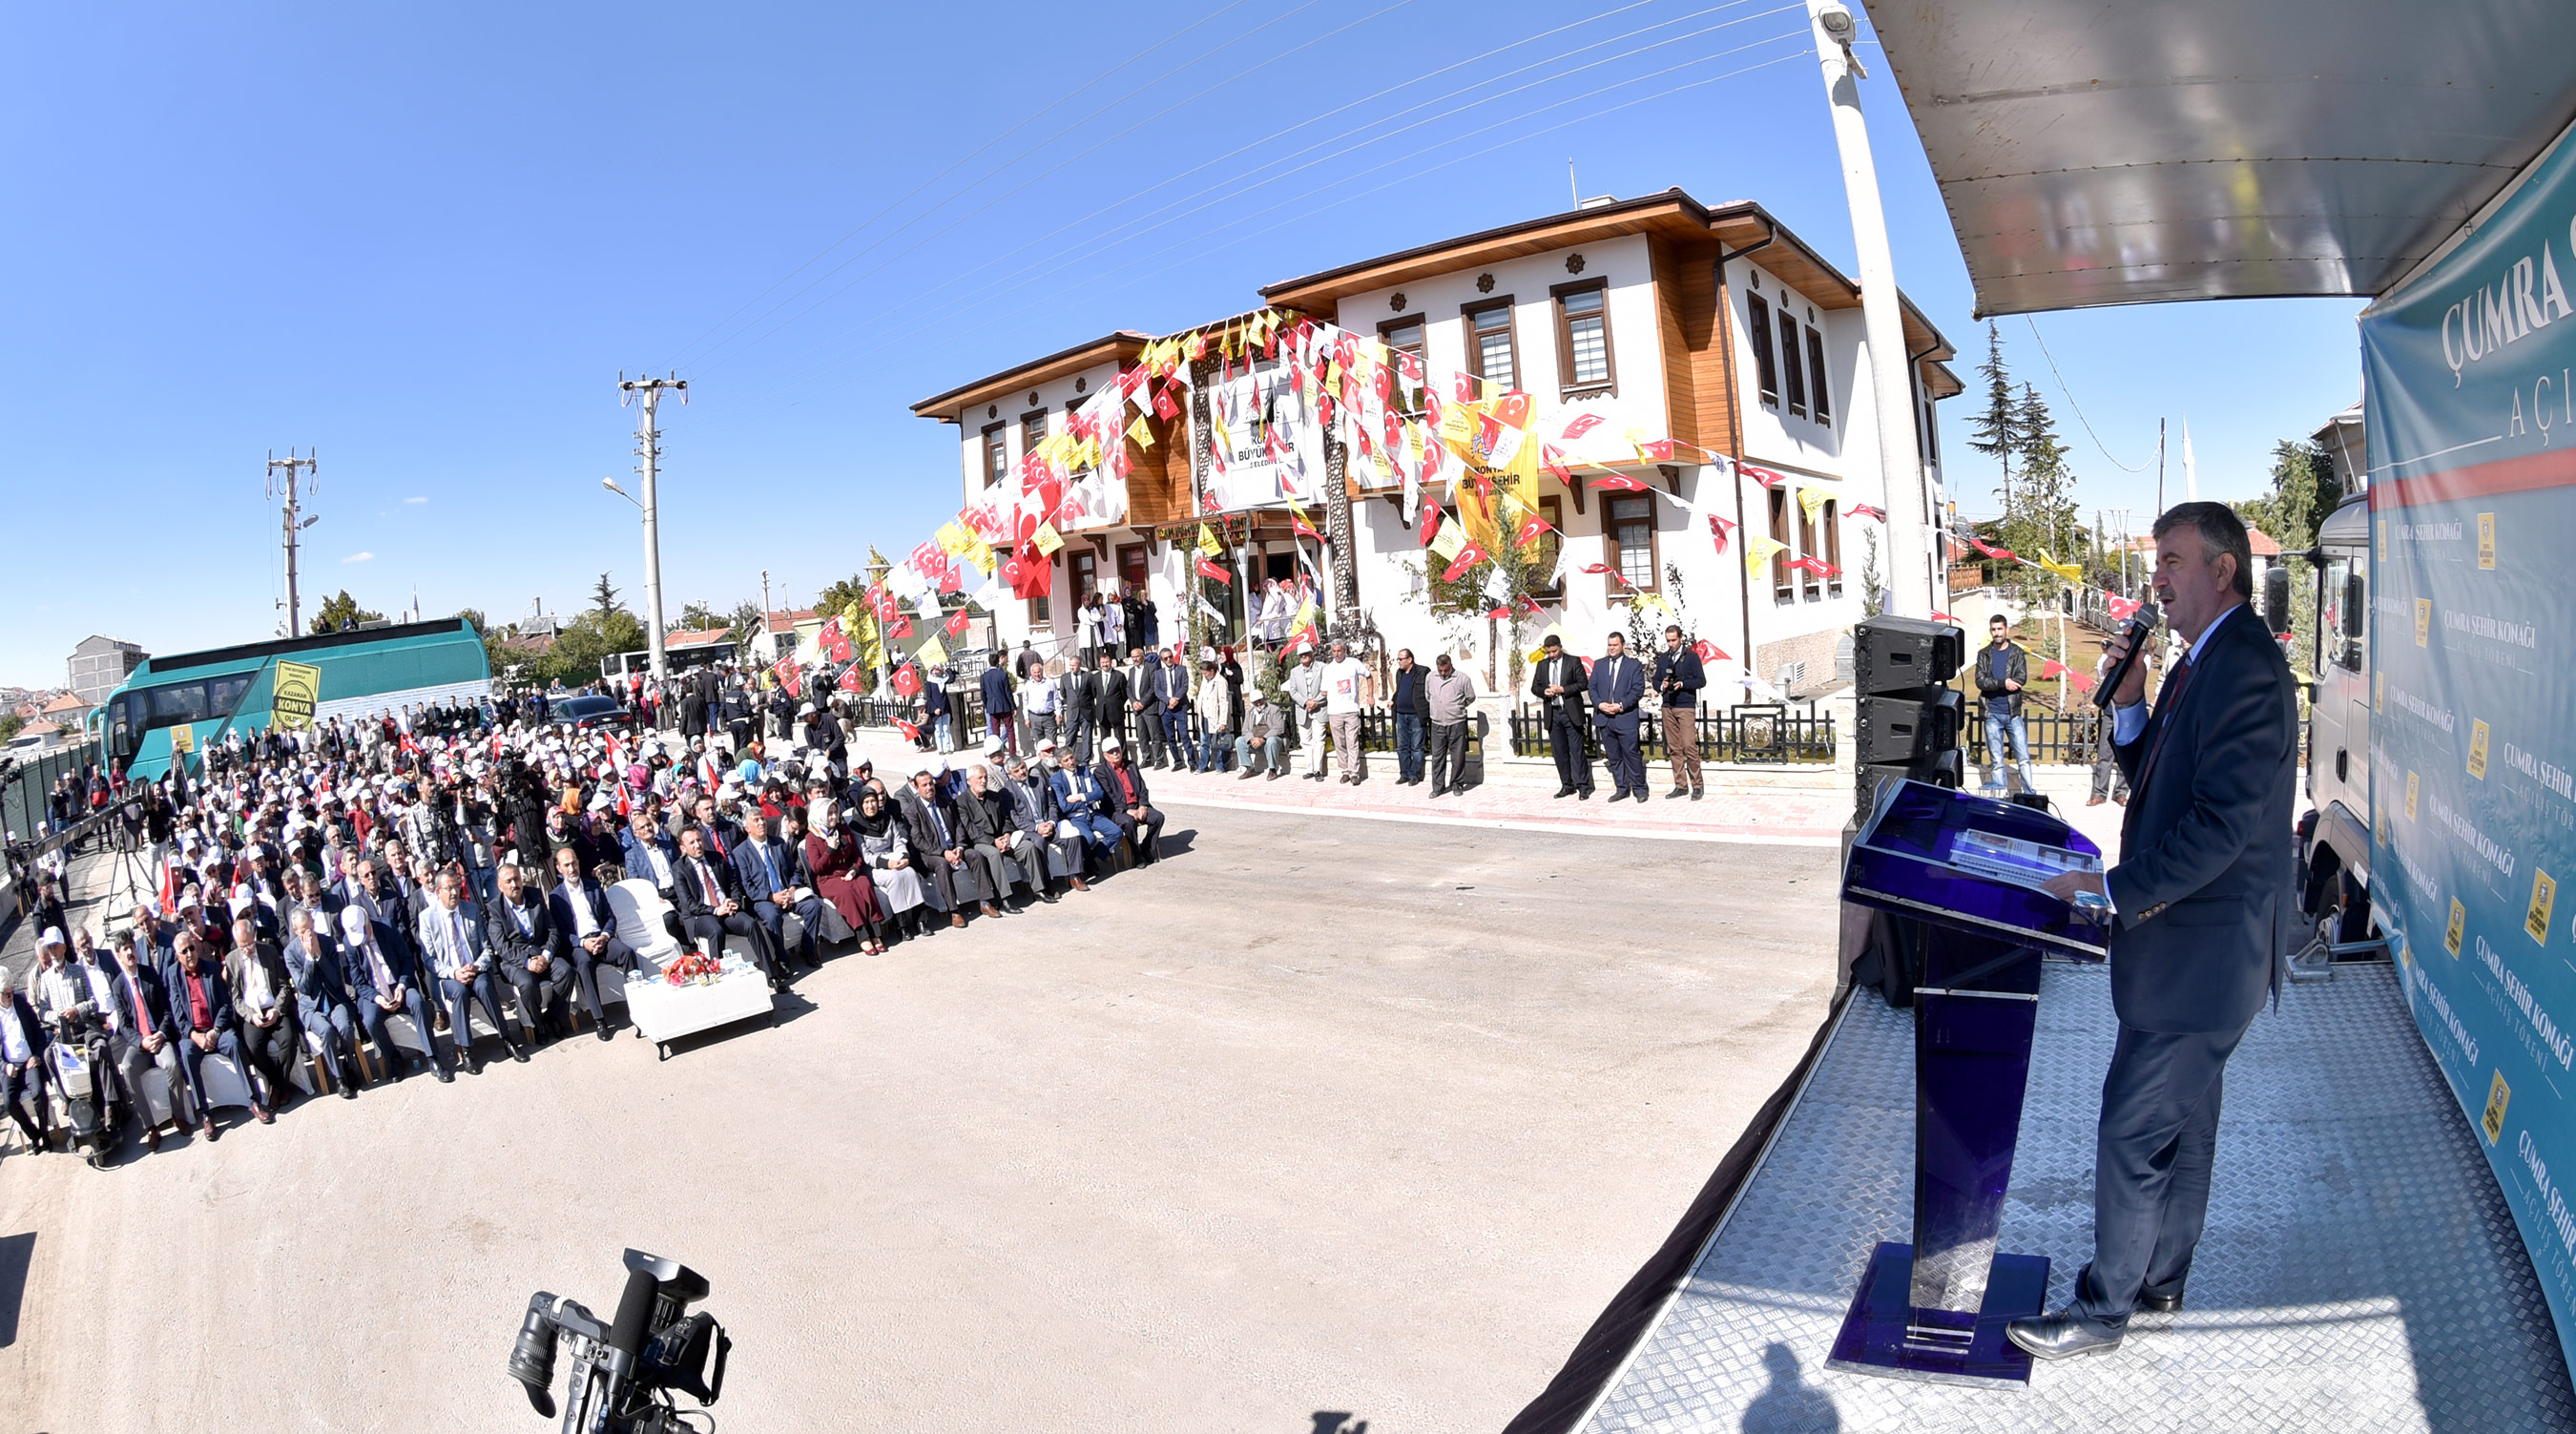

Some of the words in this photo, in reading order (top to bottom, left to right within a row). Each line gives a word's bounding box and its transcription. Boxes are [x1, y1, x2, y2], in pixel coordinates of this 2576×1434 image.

[2441, 238, 2574, 389] ÇUMRA
[2444, 610, 2470, 633] ÇUMRA
[2471, 613, 2497, 639] ŞEHİR
[2498, 620, 2535, 649] KONAĞI
[278, 698, 311, 715] KONYA
[2408, 694, 2425, 718] ŞEHİR
[2426, 704, 2455, 734] KONAĞI
[2503, 742, 2538, 780] ÇUMRA
[2539, 760, 2573, 800] ŞEHİR
[2429, 794, 2453, 829] ÇUMRA
[2453, 813, 2477, 849] ŞEHİR
[2476, 831, 2515, 879] KONAĞI
[2427, 982, 2450, 1025] ŞEHİR
[2448, 1010, 2480, 1068] KONAĞI
[2476, 934, 2504, 987] ÇUMRA
[2503, 968, 2533, 1021] ŞEHİR
[2531, 1001, 2574, 1072] KONAĞI
[2484, 981, 2512, 1027] AÇILIŞ
[2513, 1017, 2549, 1073] TÖRENİ
[2519, 1130, 2551, 1201] ÇUMRA
[2546, 1186, 2576, 1258] ŞEHİR
[2523, 1189, 2552, 1252] AÇILIŞ
[2550, 1246, 2576, 1327] TÖREN
